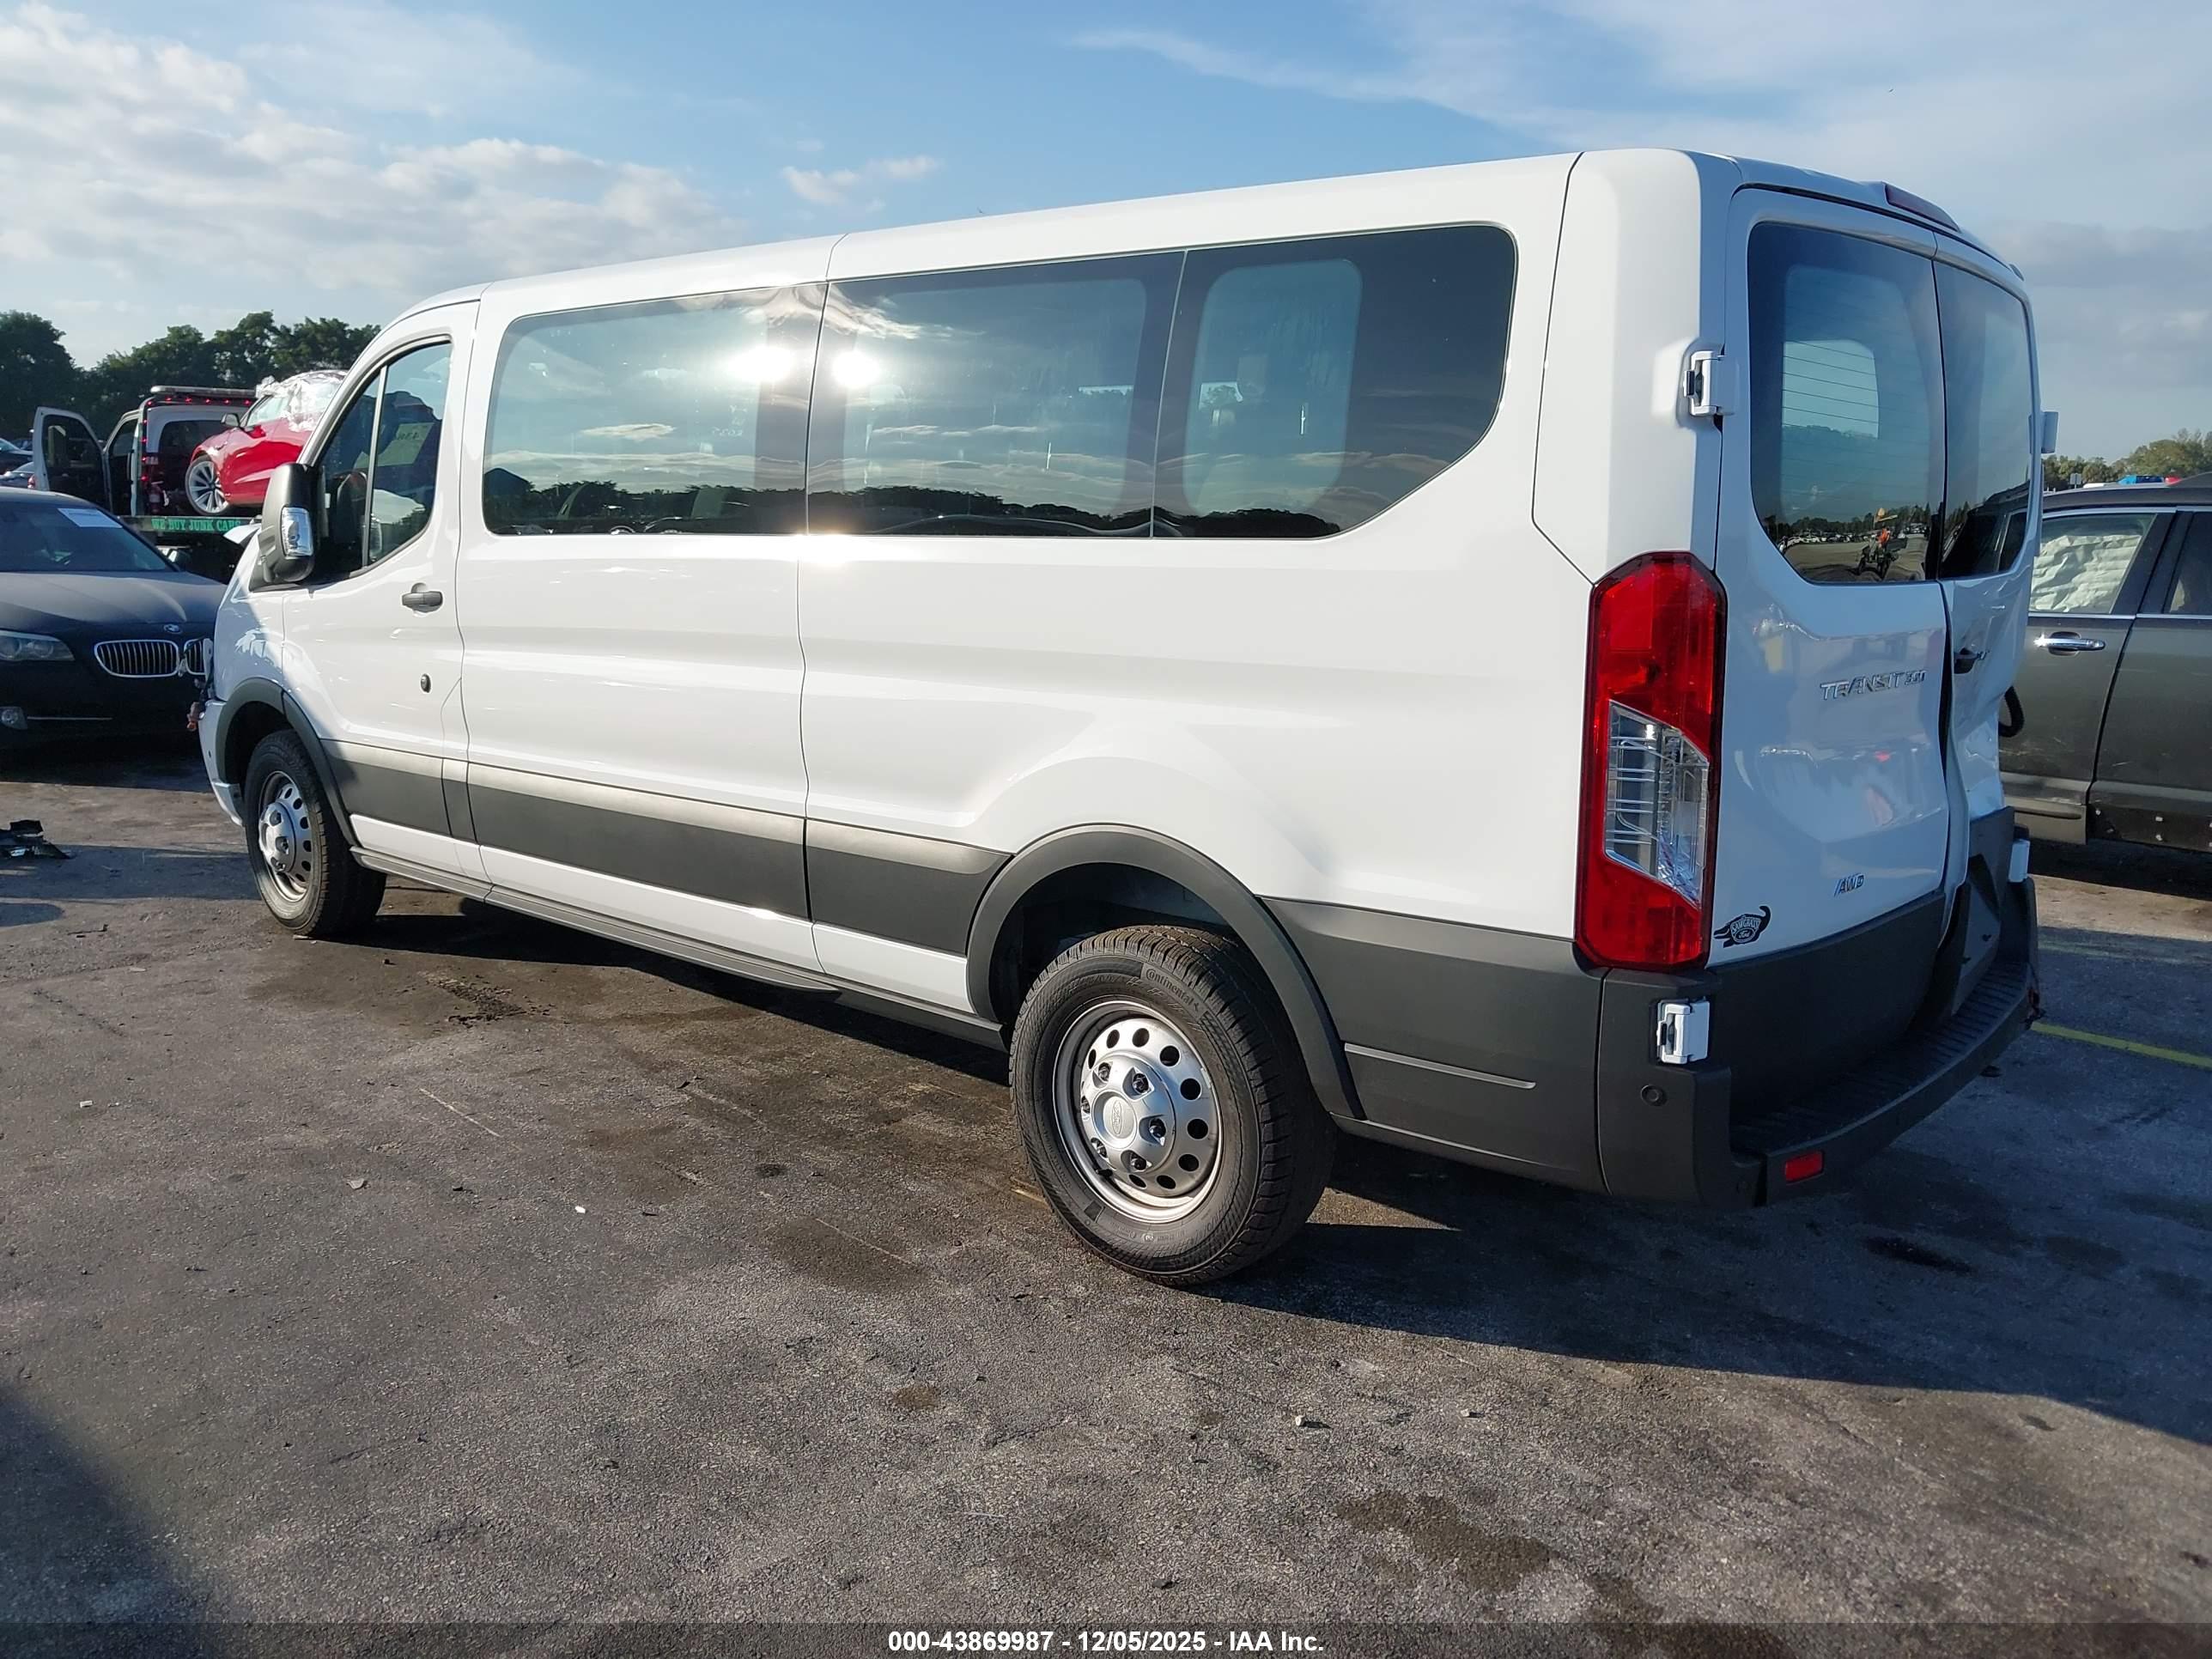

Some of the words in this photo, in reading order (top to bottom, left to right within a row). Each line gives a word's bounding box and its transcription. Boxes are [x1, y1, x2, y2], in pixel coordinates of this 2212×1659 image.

[151, 519, 166, 530] WE
[167, 519, 185, 530] BUY
[189, 520, 214, 532] JUNK
[1820, 672, 1905, 700] TRANSIT
[1834, 873, 1864, 896] AWD
[1146, 968, 1194, 1006] Continental
